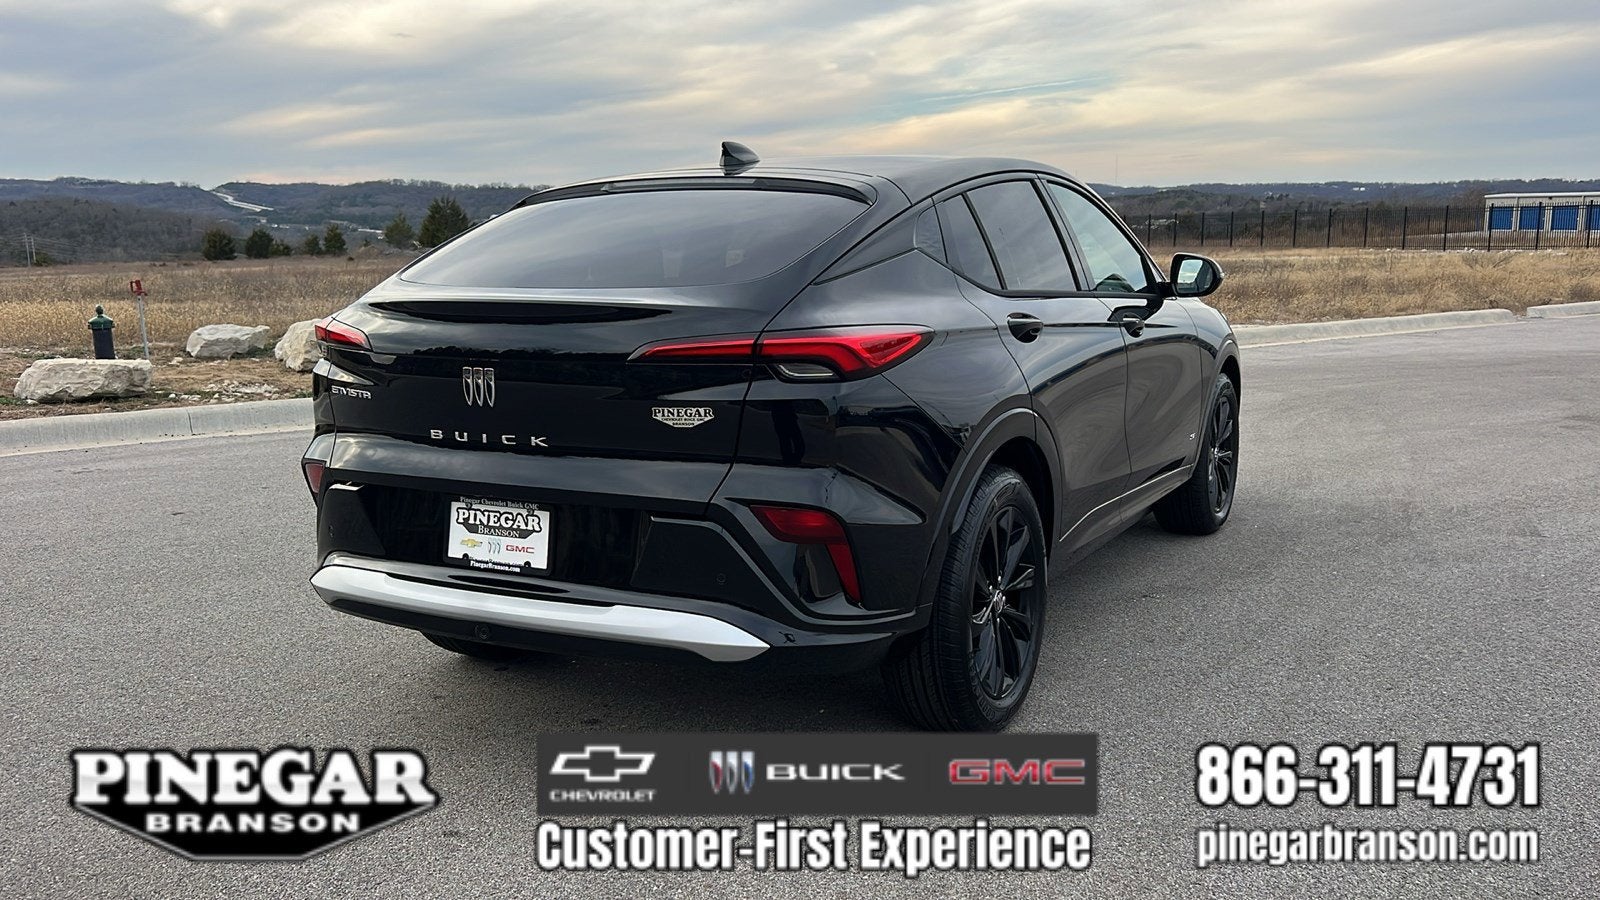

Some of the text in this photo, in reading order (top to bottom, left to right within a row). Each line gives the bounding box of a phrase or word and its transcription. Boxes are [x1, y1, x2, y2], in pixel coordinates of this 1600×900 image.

[653, 408, 714, 417] PINEGAR
[430, 429, 549, 447] BUICK
[460, 496, 481, 504] Pinegar
[481, 498, 507, 507] Chevrolet
[524, 502, 540, 510] GMC
[457, 508, 542, 531] PINEGAR
[477, 525, 520, 538] BRANSON
[505, 544, 535, 554] GMC
[470, 560, 521, 572] PinegarBranson.com
